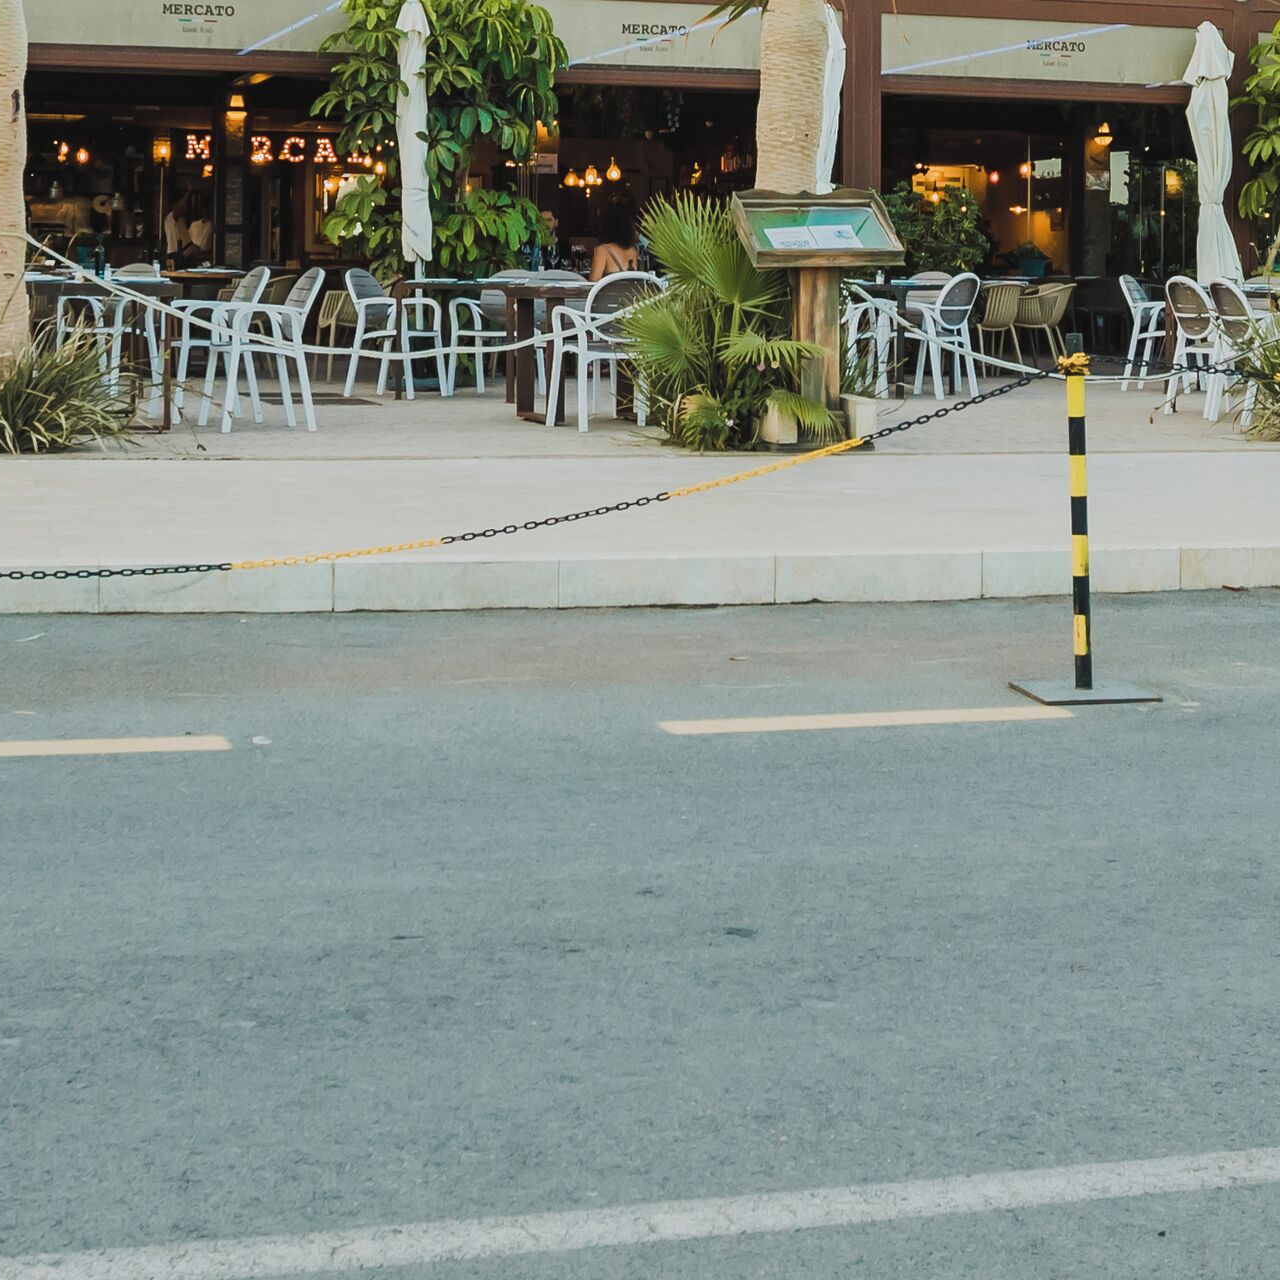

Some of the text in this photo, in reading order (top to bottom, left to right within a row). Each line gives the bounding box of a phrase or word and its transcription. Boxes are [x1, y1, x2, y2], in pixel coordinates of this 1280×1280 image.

[162, 3, 235, 17] MERCATO
[621, 23, 689, 36] MERCATO
[1026, 39, 1086, 52] MERCATO
